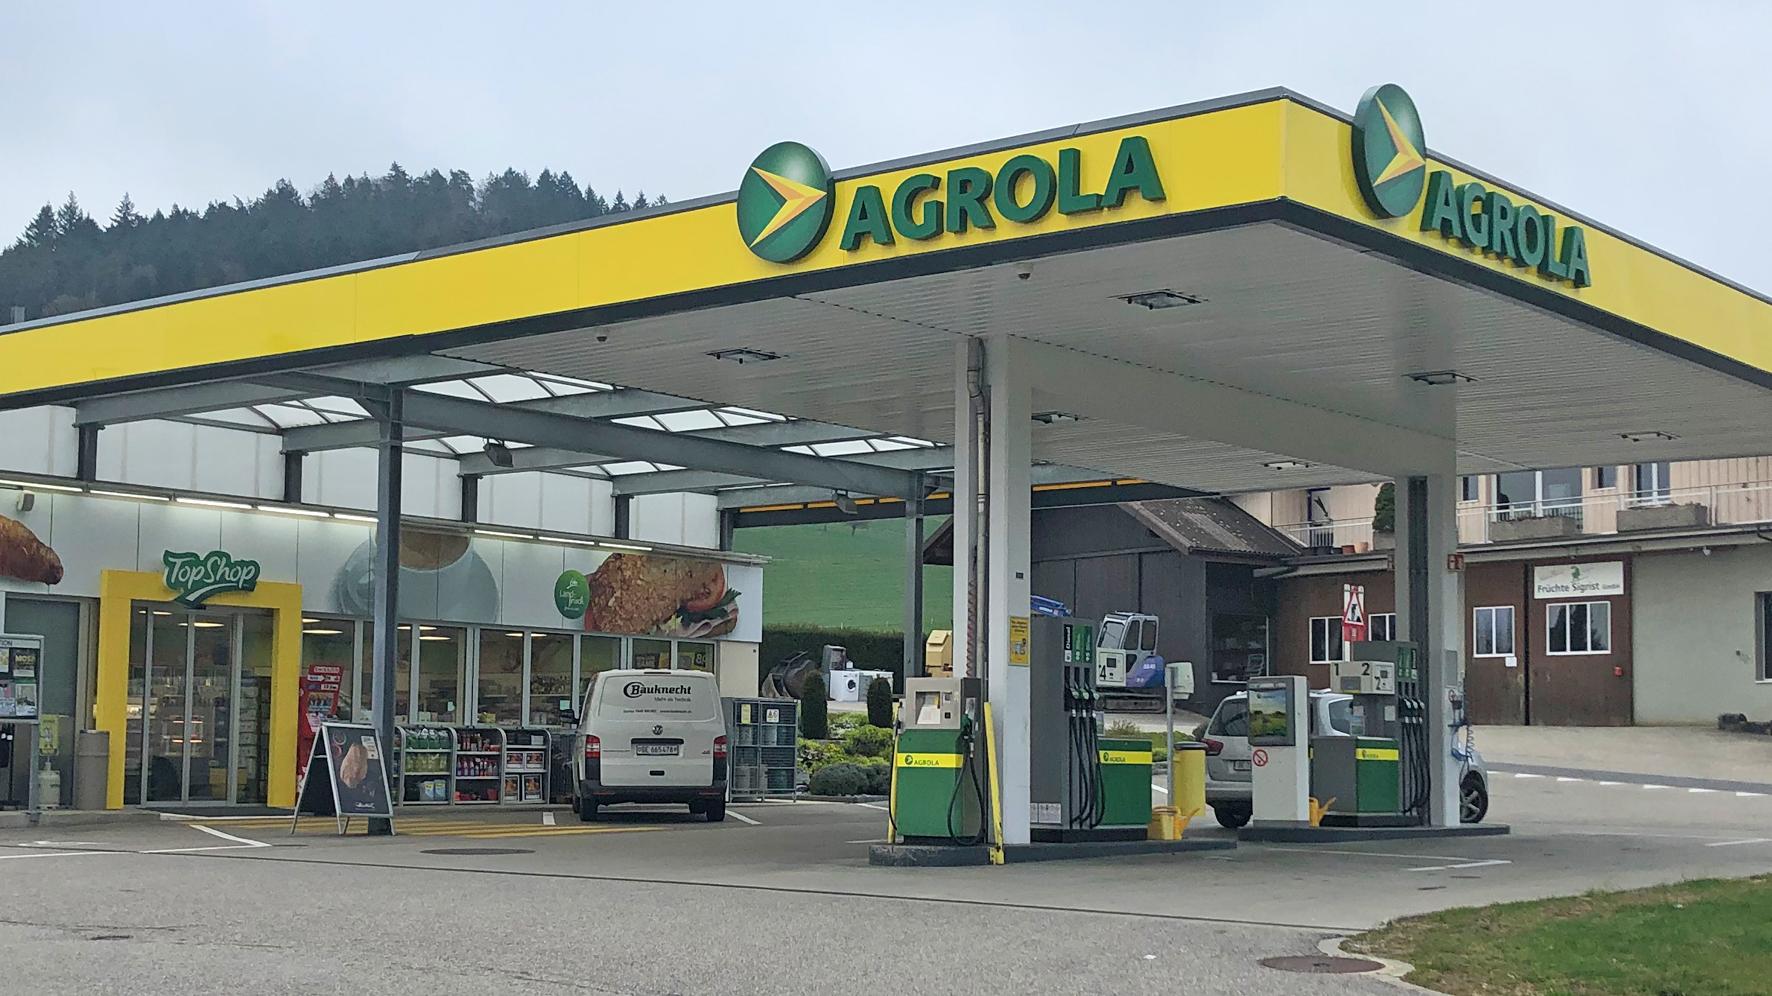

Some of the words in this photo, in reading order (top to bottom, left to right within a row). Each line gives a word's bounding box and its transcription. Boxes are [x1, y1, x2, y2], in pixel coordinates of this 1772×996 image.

[839, 136, 1166, 251] AGROLA
[1420, 170, 1591, 289] AGROLA
[1537, 583, 1570, 593] Früchte
[1571, 582, 1600, 593] Sigrist
[1100, 665, 1107, 680] 4
[1334, 663, 1339, 676] 1
[1361, 662, 1370, 676] 2
[626, 682, 692, 696] Bauknecht
[1374, 676, 1381, 690] 2
